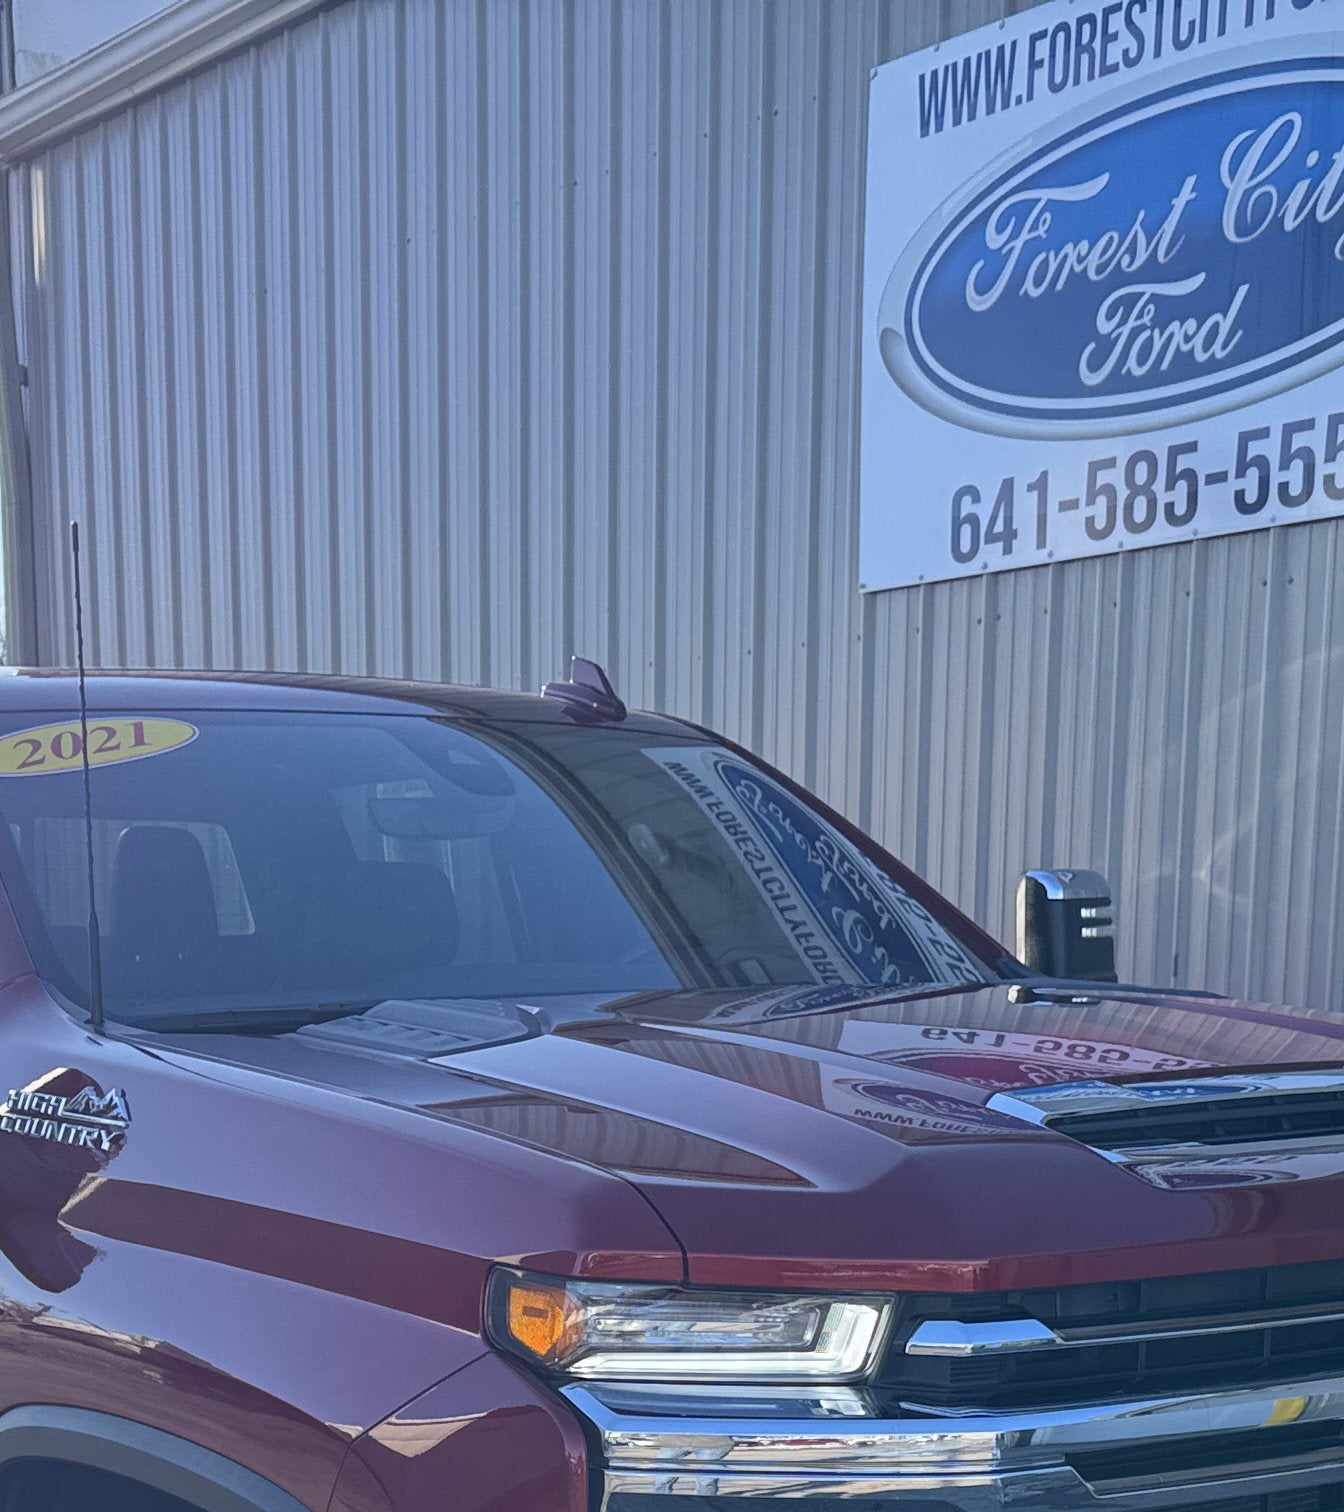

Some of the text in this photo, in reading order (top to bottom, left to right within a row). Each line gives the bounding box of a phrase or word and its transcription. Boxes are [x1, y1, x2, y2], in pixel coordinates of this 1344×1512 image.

[965, 172, 1197, 313] Forest
[1079, 271, 1250, 387] Ford
[13, 721, 153, 771] 2021
[8, 1089, 68, 1117] HIGH
[0, 1112, 123, 1151] COUNTRY
